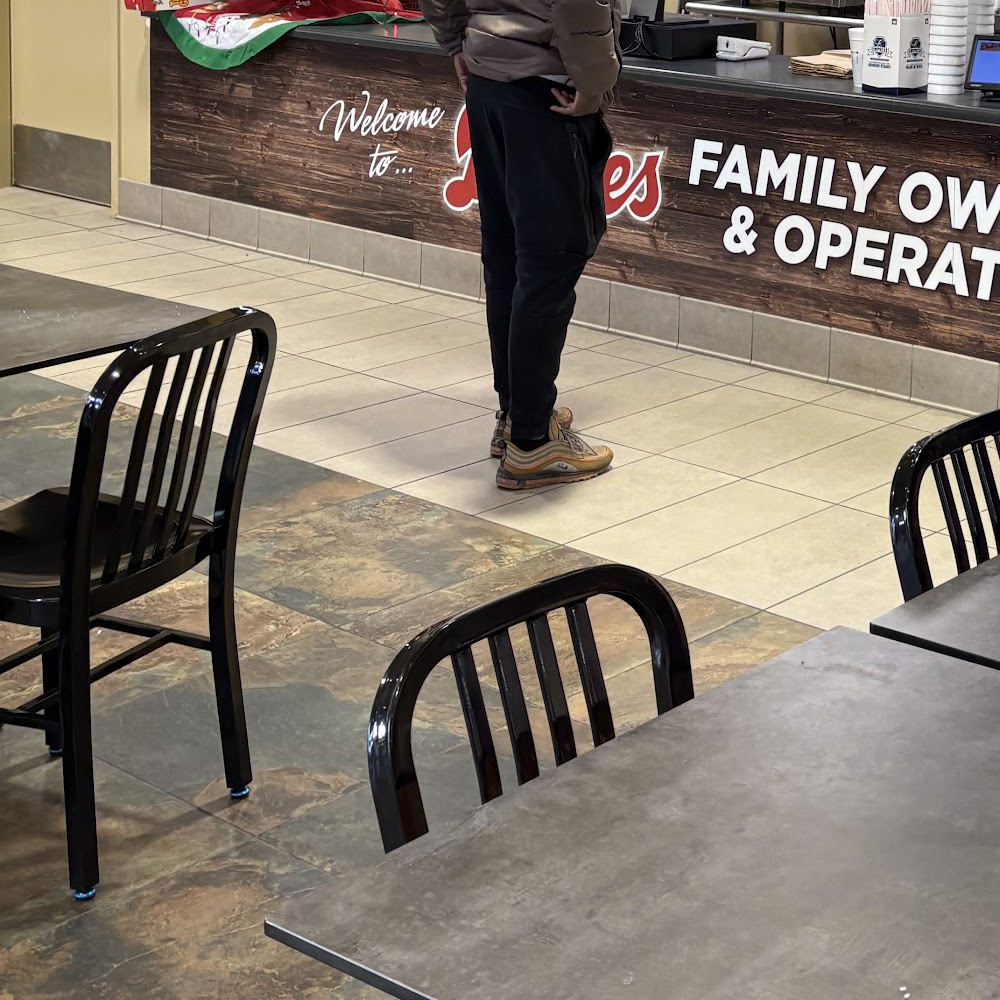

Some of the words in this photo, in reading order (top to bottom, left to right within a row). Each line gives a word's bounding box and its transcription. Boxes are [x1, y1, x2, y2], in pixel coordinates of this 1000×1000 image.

[319, 90, 445, 143] Welcome
[688, 138, 886, 213] FAMILY
[722, 205, 758, 256] &
